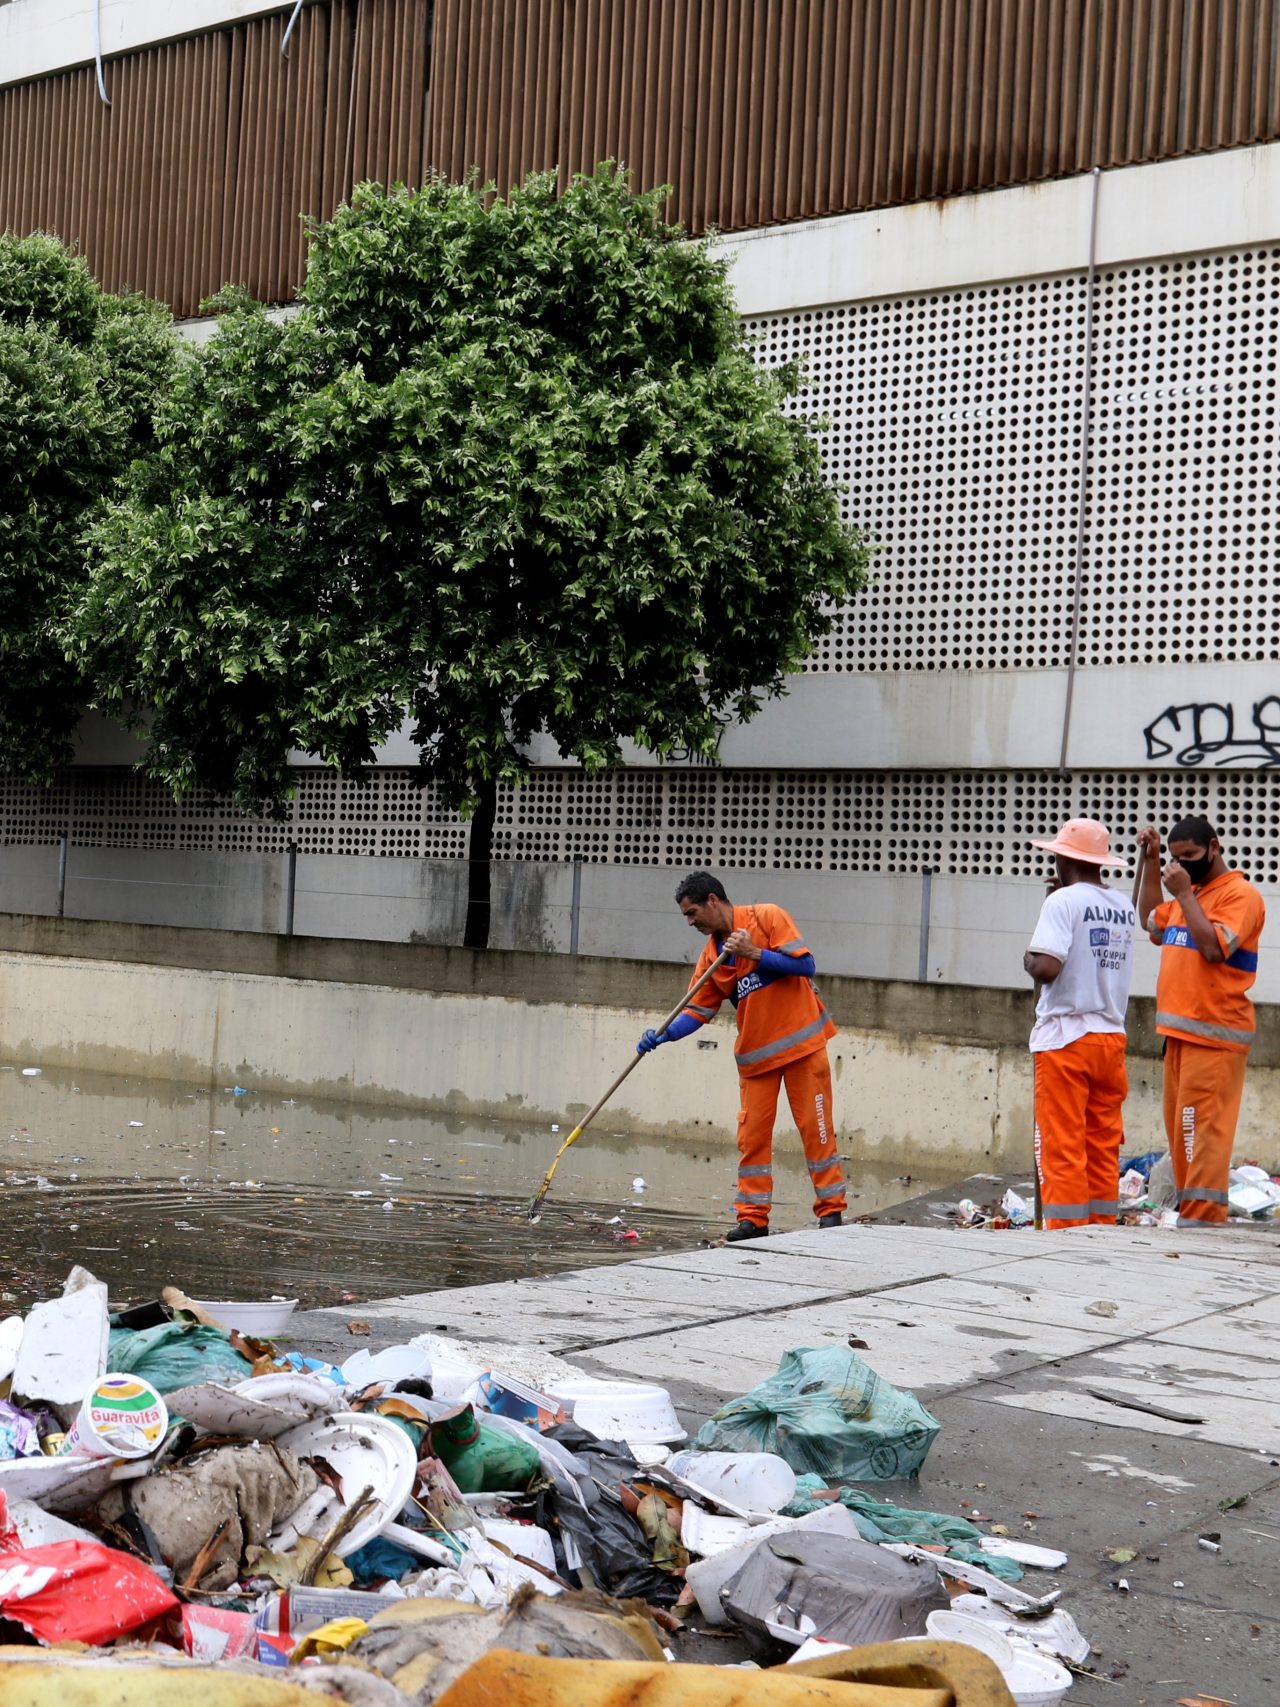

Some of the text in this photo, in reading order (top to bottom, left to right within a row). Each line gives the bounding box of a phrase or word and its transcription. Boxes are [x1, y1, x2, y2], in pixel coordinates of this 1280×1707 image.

[1083, 906, 1135, 926] ALUNO
[815, 1093, 827, 1144] COMLURB
[1183, 1106, 1195, 1163] COMLURB
[91, 1408, 161, 1425] Guaravita
